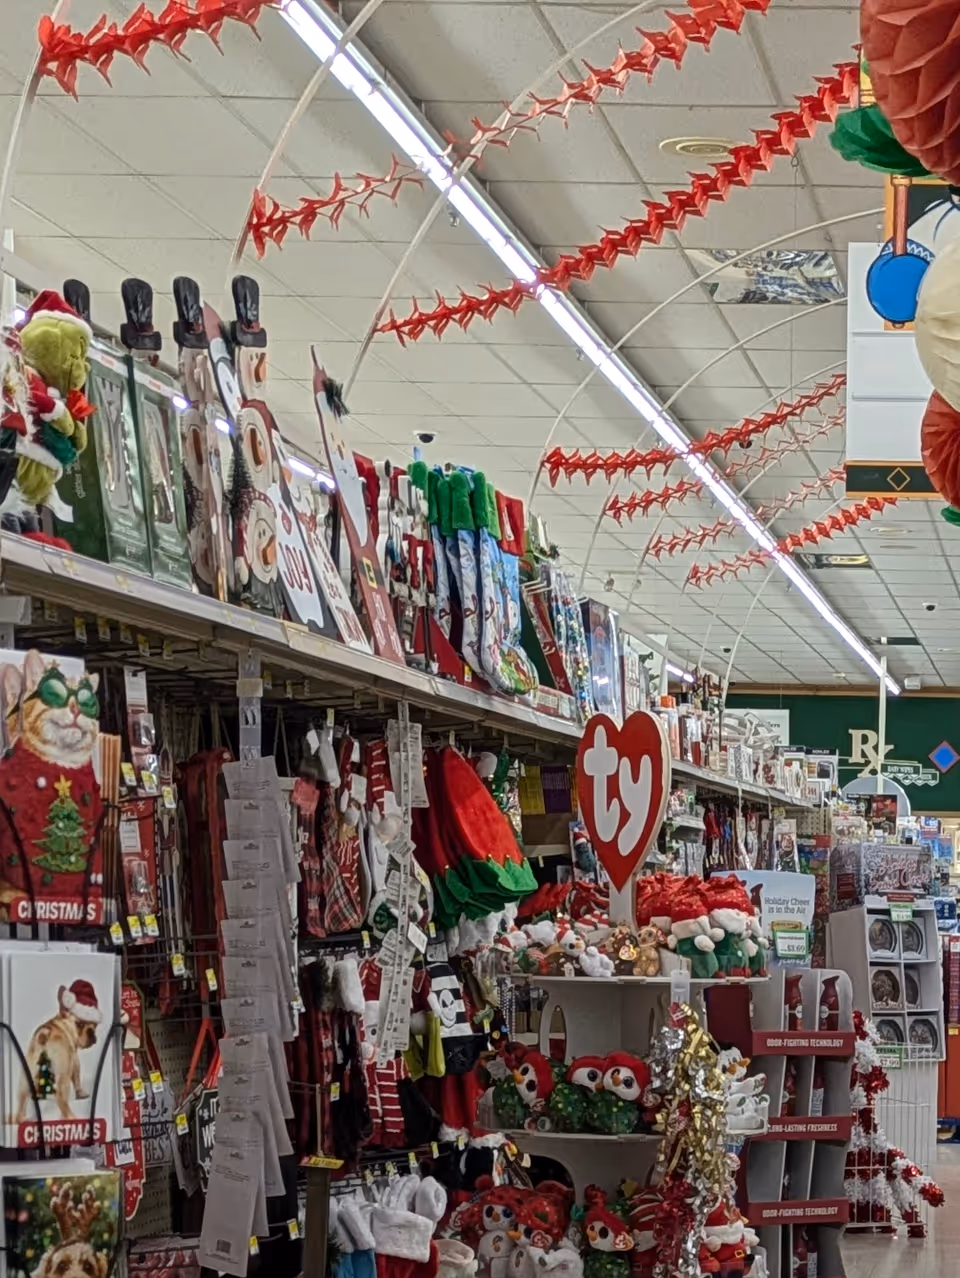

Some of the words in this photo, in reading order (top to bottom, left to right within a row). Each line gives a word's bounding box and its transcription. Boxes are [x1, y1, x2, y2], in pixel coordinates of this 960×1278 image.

[278, 541, 313, 594] JOY
[583, 725, 652, 857] ty
[764, 896, 790, 908] Holiday
[790, 897, 811, 906] Cheer
[768, 906, 773, 914] is
[775, 906, 783, 914] in
[783, 906, 795, 914] the
[796, 906, 806, 914] Air
[766, 1038, 810, 1047] ODOR-FIGHTING
[810, 1039, 844, 1048] TECHNOLOGY
[807, 1123, 838, 1132] FRESHNESS
[762, 1208, 804, 1218] ODOR-FIGHTING
[804, 1207, 838, 1216] TECHNOLOGY
